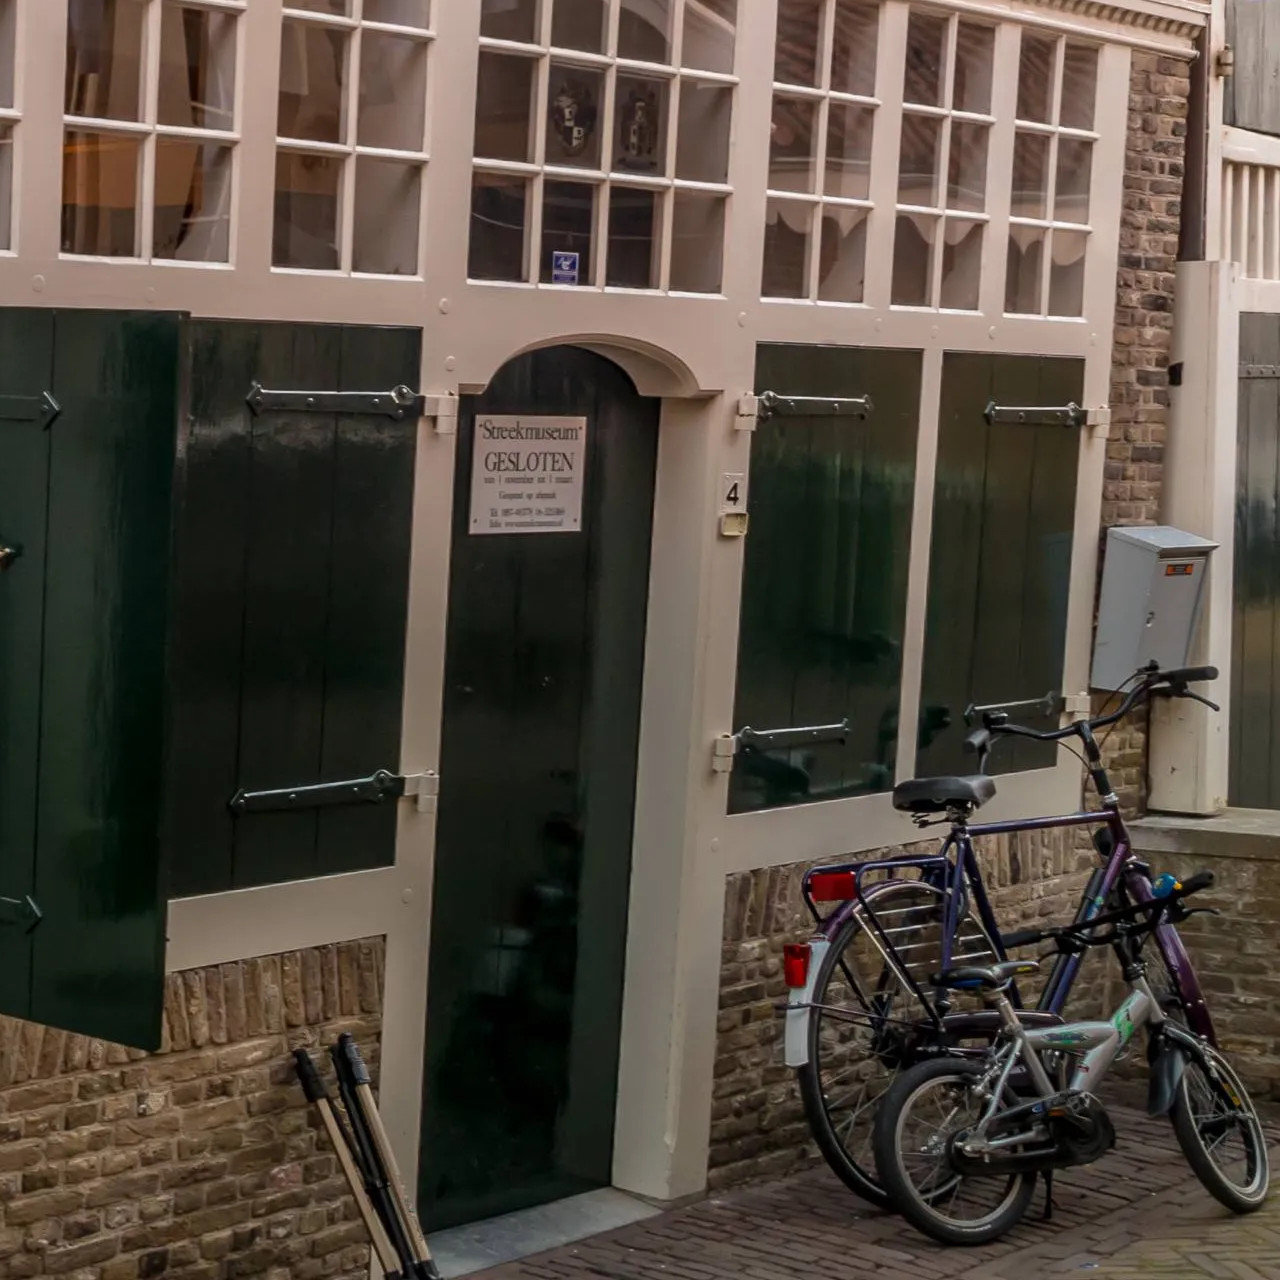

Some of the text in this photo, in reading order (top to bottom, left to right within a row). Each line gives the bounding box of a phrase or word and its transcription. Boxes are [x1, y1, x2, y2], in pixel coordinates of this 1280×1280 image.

[482, 419, 578, 440] Streekmuseum
[484, 451, 574, 472] GESLOTEN
[726, 482, 739, 506] 4
